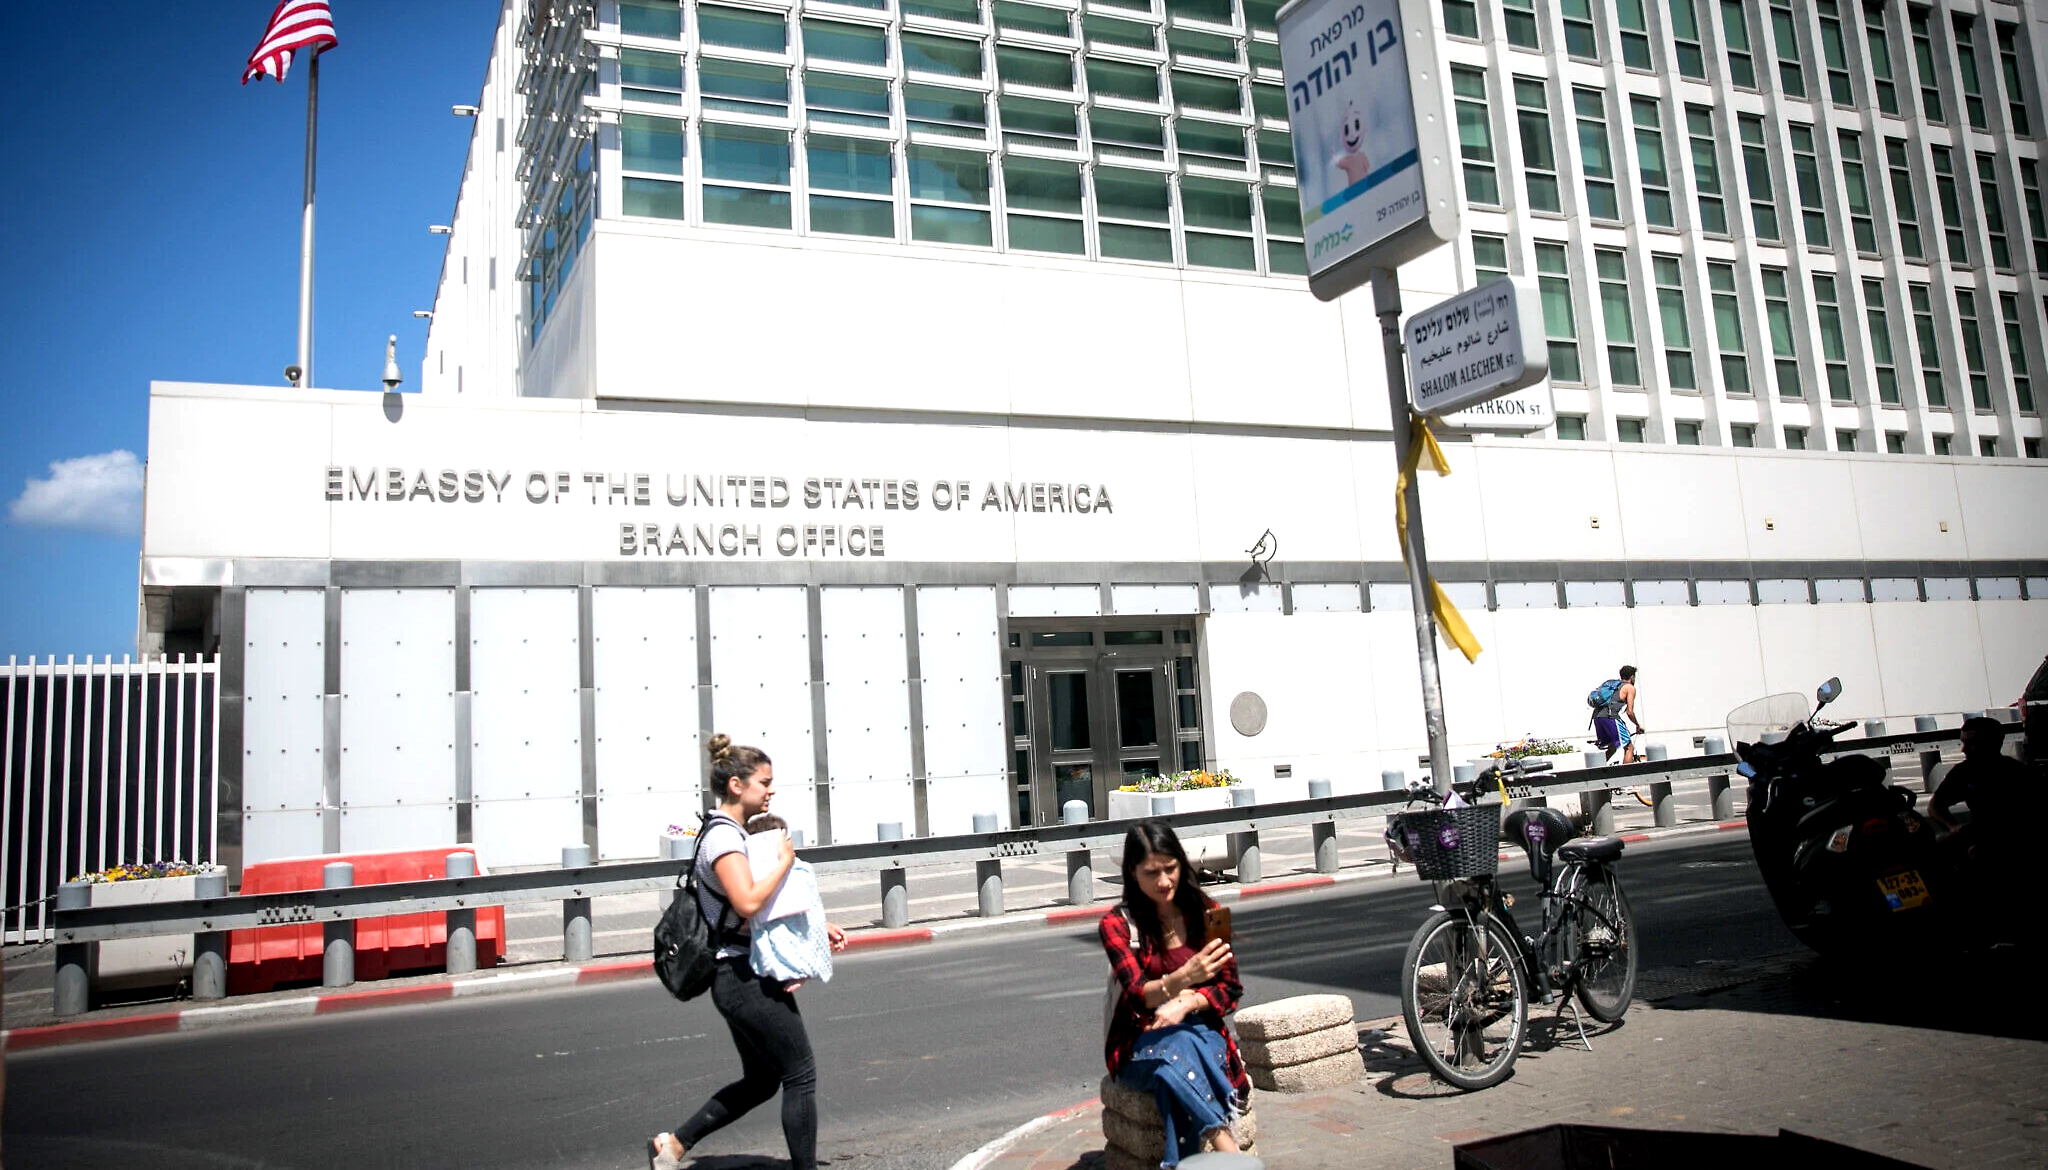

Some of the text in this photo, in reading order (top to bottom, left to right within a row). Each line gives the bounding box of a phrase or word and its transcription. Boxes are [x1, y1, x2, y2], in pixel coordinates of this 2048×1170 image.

[1310, 5, 1364, 58] מרפאת
[1292, 19, 1397, 113] בן יהודה
[1376, 190, 1421, 222] בן יהודה 29
[1313, 230, 1341, 259] כללית
[1414, 317, 1443, 344] עליכם
[1446, 304, 1470, 332] שלום
[1487, 320, 1510, 346] شارع
[1457, 331, 1482, 355] شالوم
[1420, 353, 1518, 399] SHALOM ALECHEM ST.
[1529, 404, 1545, 415] ST.
[324, 465, 1113, 514] EMBASSY OF THE UNITED STATES OF AMERICA
[619, 522, 885, 557] BRANCH OFFICE
